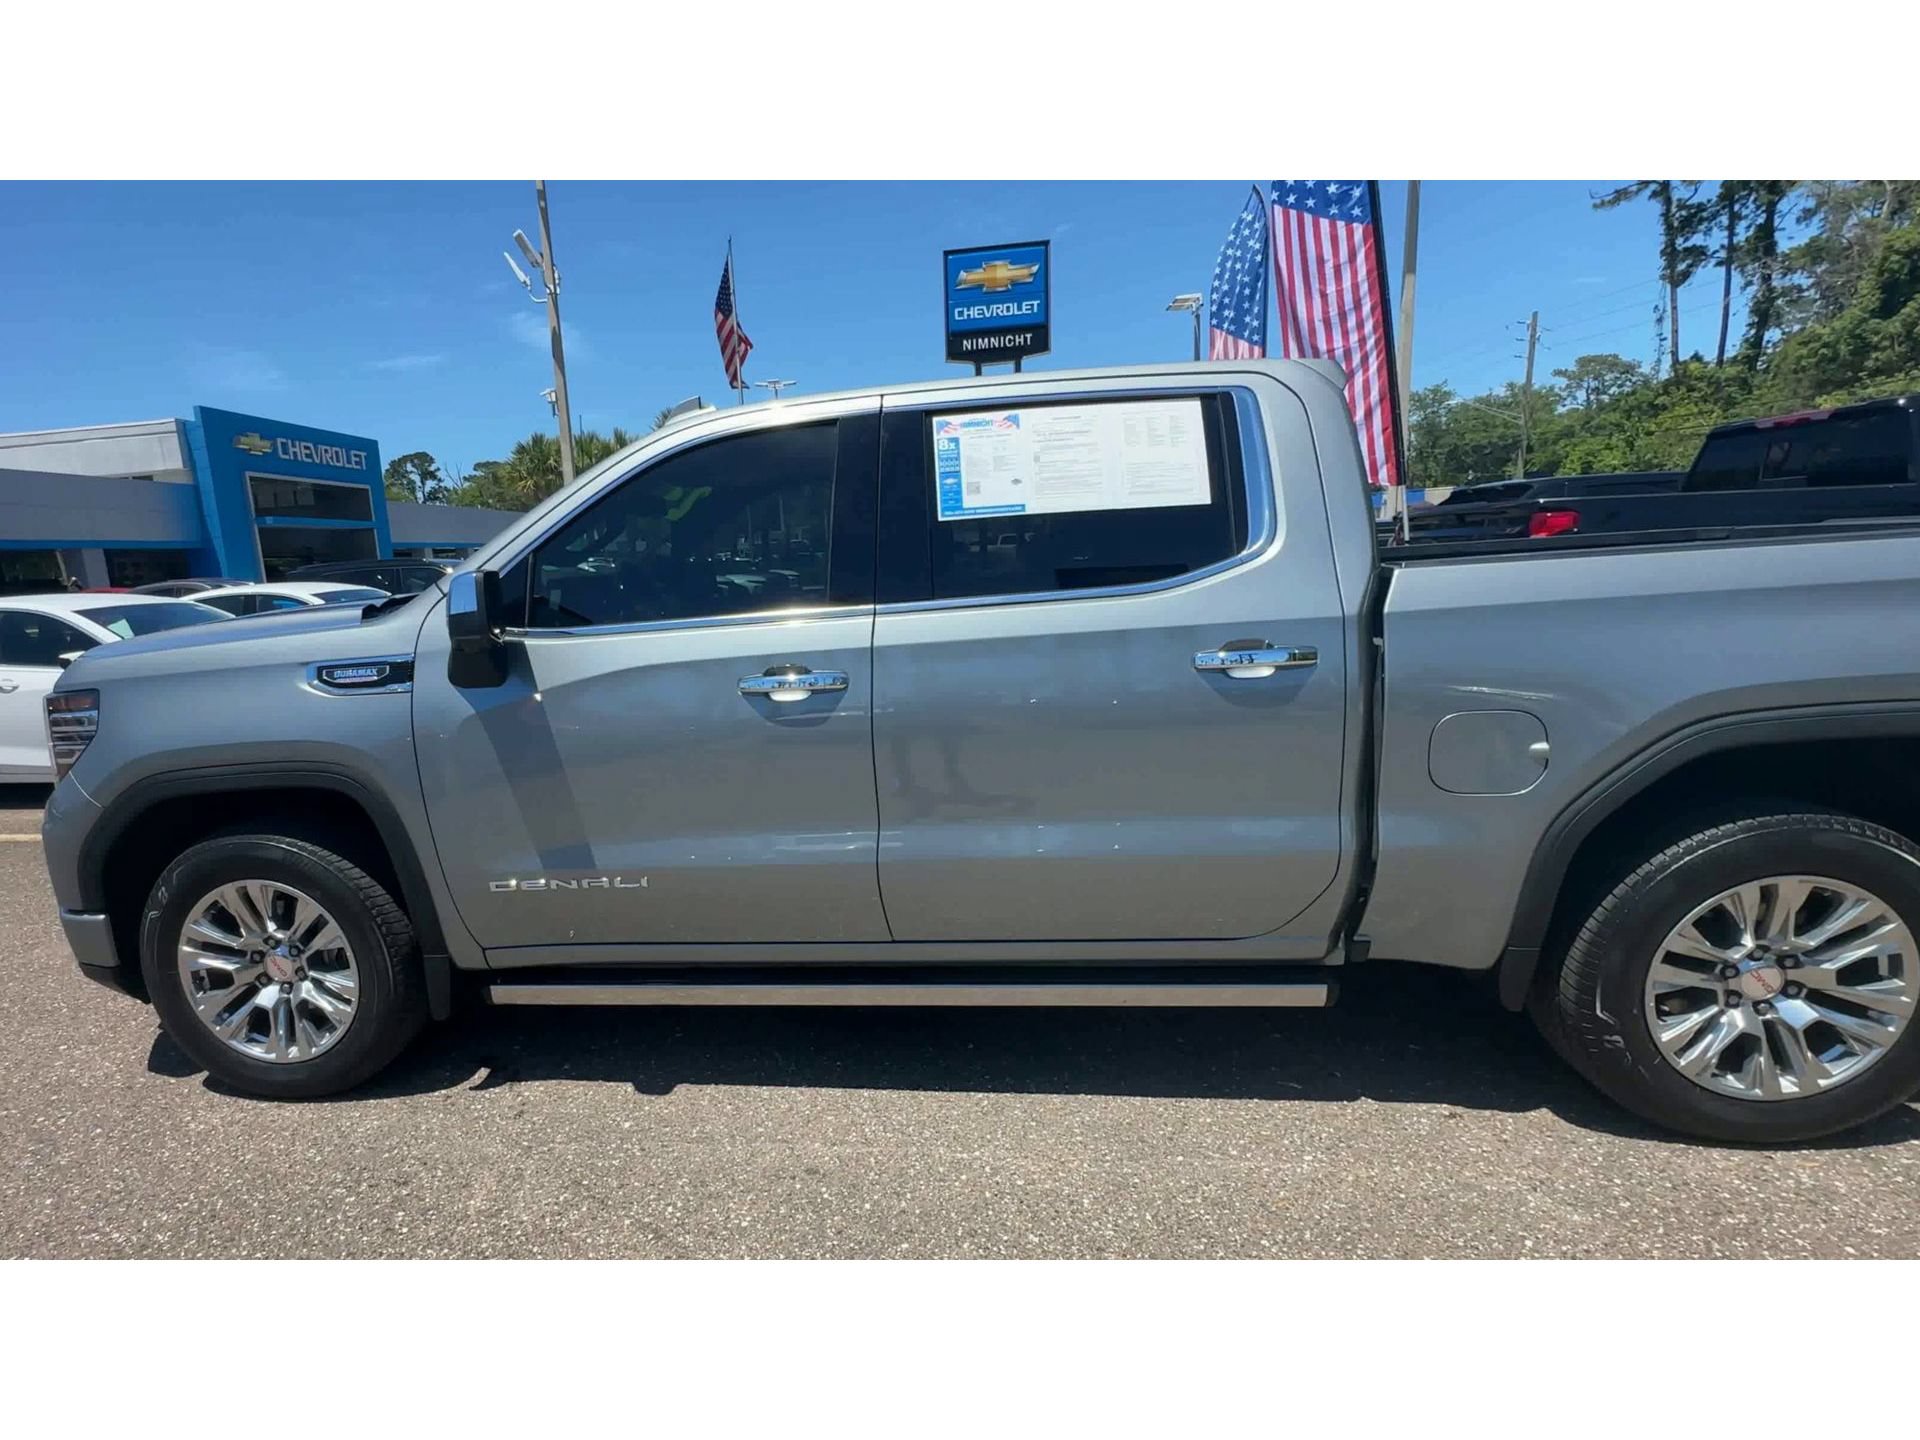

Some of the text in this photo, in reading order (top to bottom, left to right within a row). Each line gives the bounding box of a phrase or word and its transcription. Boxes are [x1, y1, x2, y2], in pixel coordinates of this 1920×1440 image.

[954, 300, 1040, 321] CHEVROLET
[962, 333, 1033, 351] NIMNICHT
[276, 437, 367, 471] CHEVROLET
[333, 667, 379, 679] DURAMAX
[488, 876, 649, 892] DENALI
[1750, 968, 1776, 994] GMC
